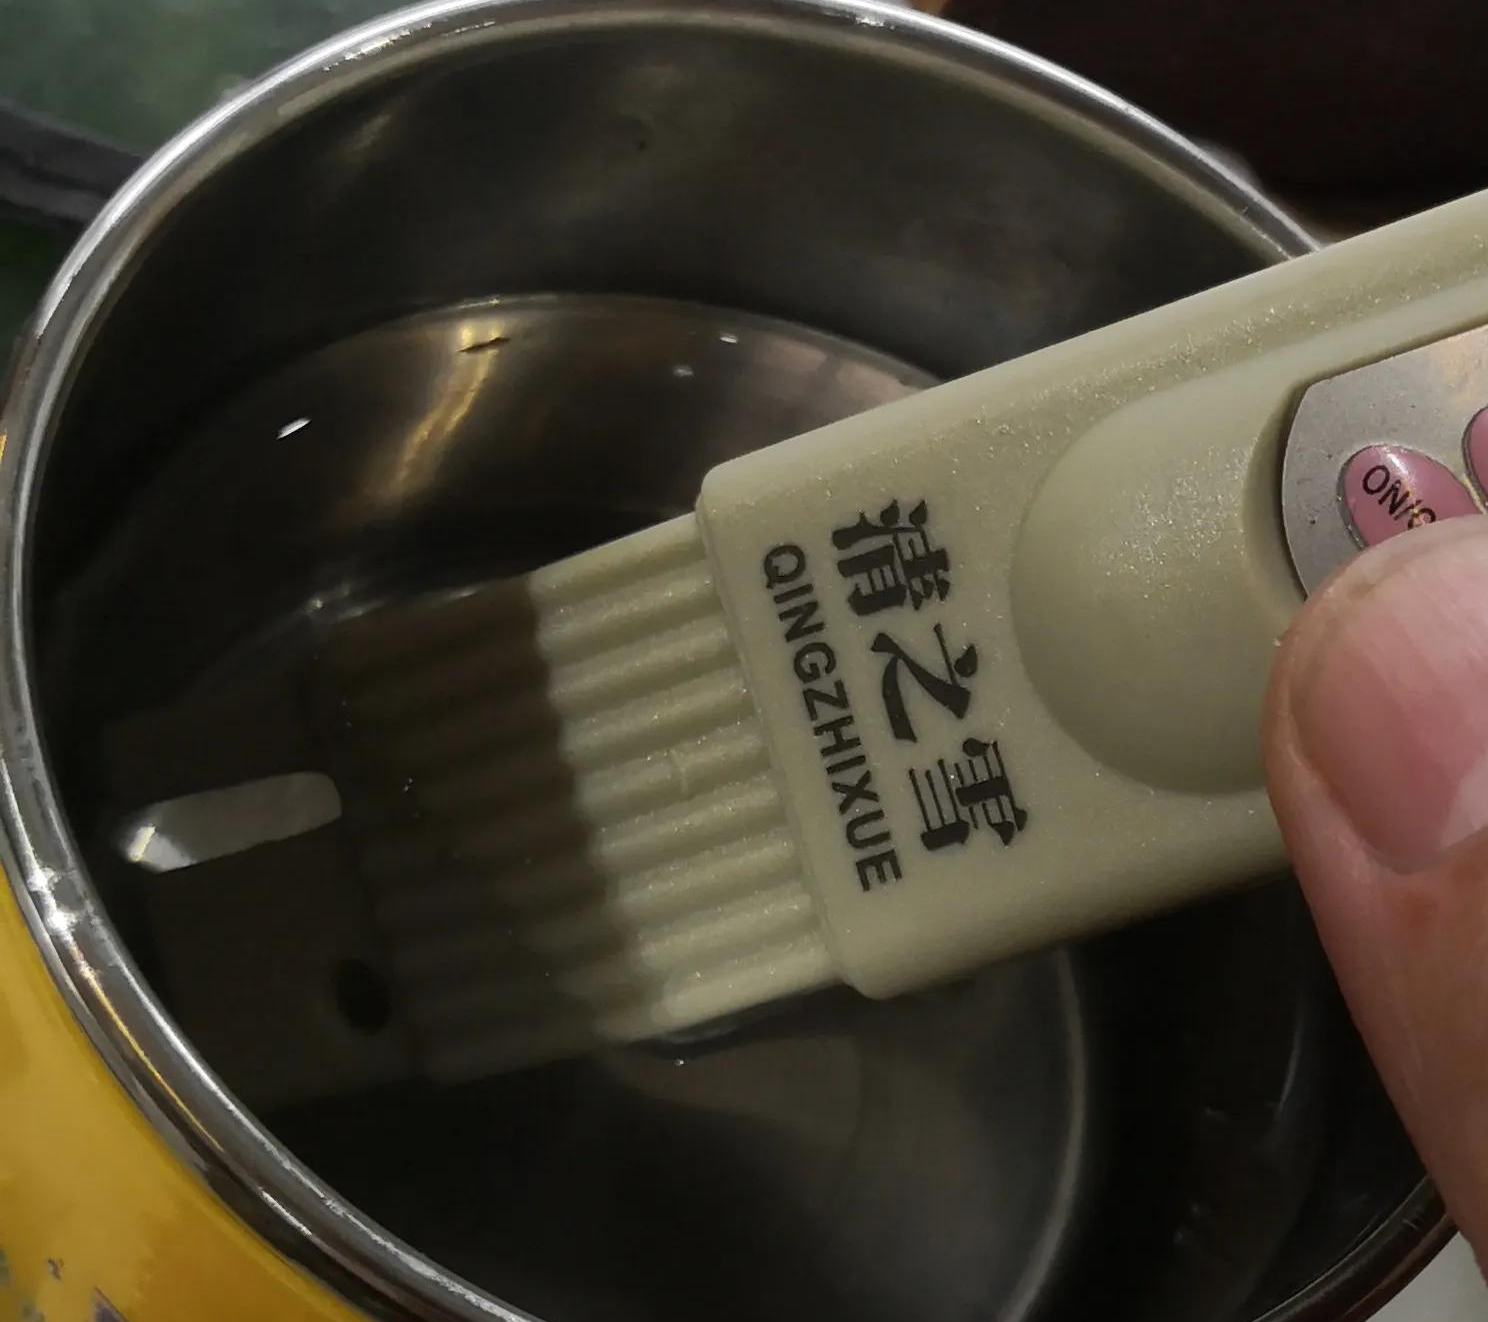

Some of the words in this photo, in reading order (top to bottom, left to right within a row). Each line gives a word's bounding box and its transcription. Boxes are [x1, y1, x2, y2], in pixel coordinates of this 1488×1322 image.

[763, 544, 902, 891] QINGZHIXUE
[832, 499, 1027, 851] 清之雪
